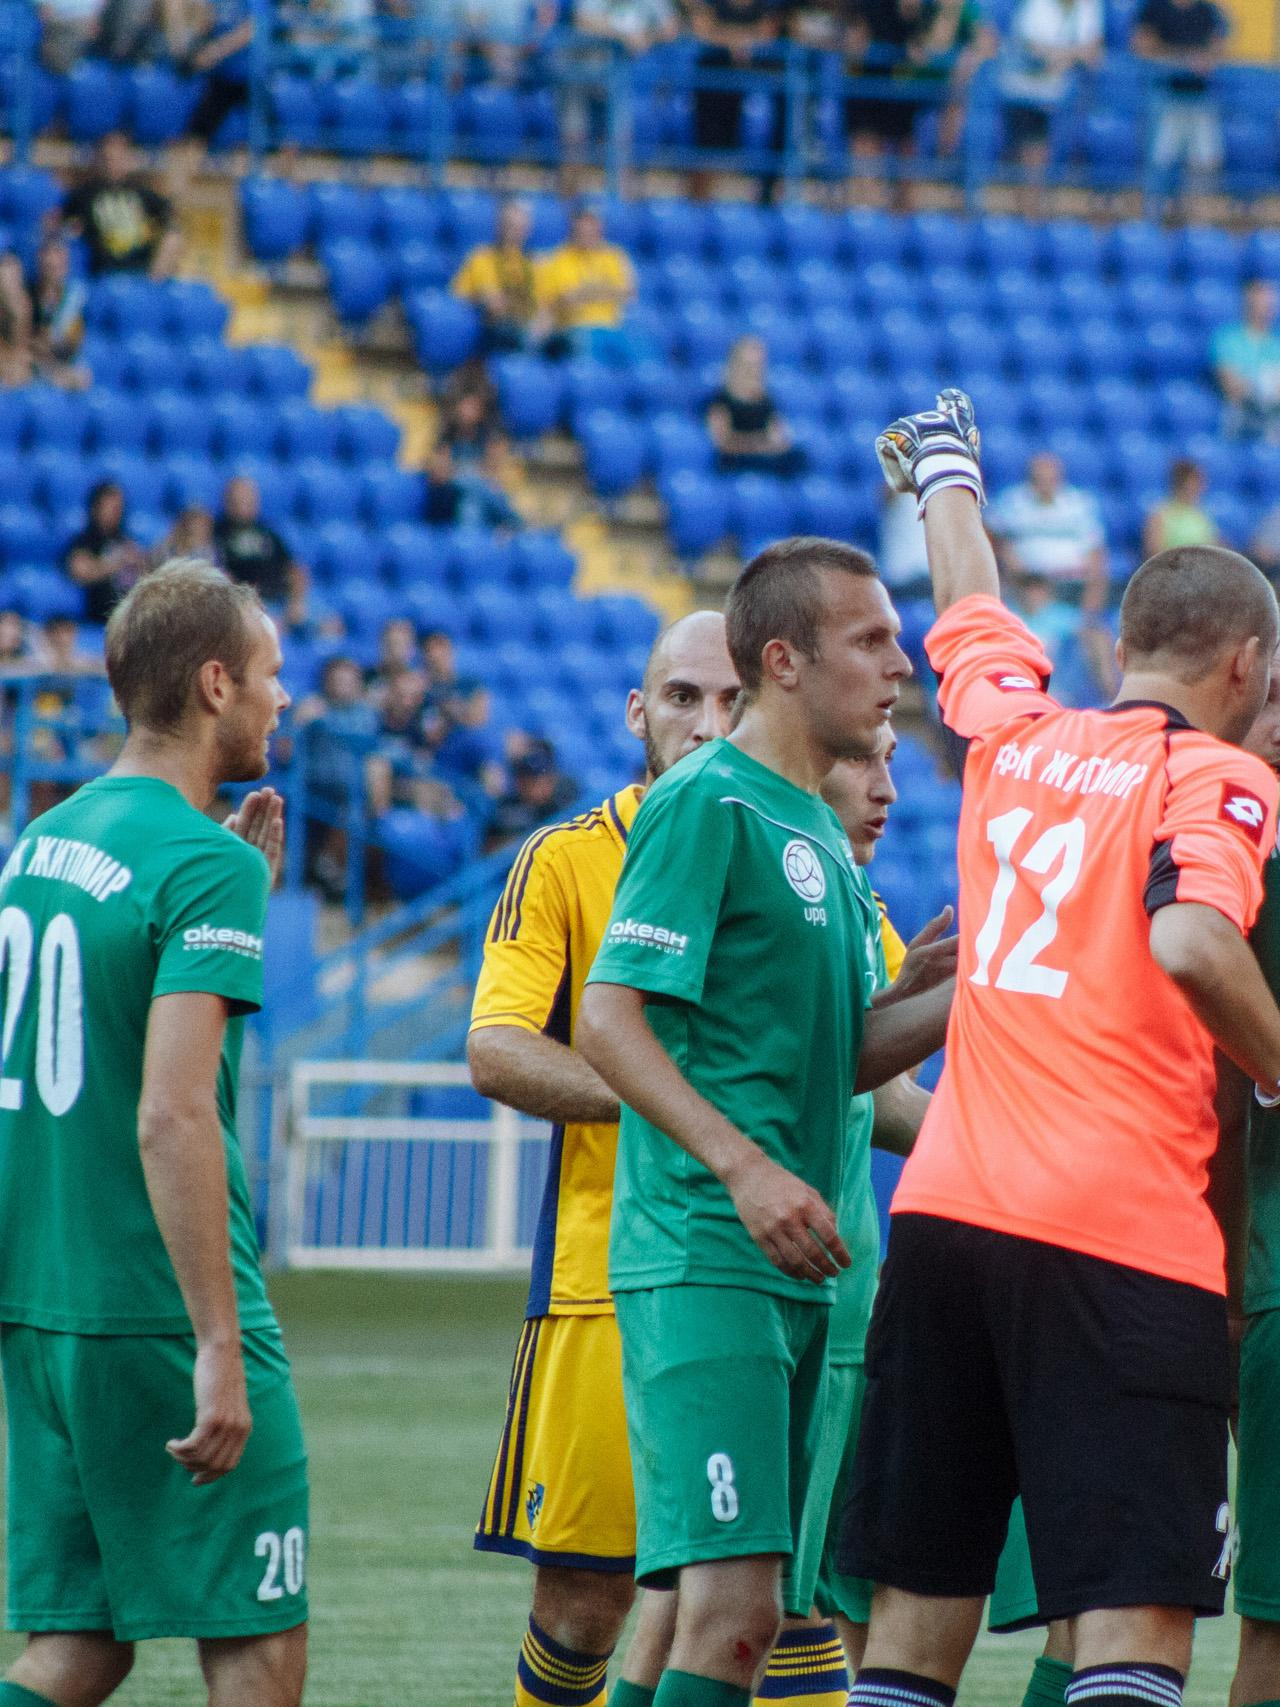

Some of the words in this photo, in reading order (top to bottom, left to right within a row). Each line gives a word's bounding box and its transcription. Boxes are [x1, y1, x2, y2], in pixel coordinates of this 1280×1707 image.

[25, 836, 132, 902] ЖИТОМИР
[969, 806, 1086, 999] 12
[804, 906, 828, 926] upg
[0, 906, 84, 1117] 20
[707, 1453, 739, 1523] 8
[254, 1526, 304, 1601] 20
